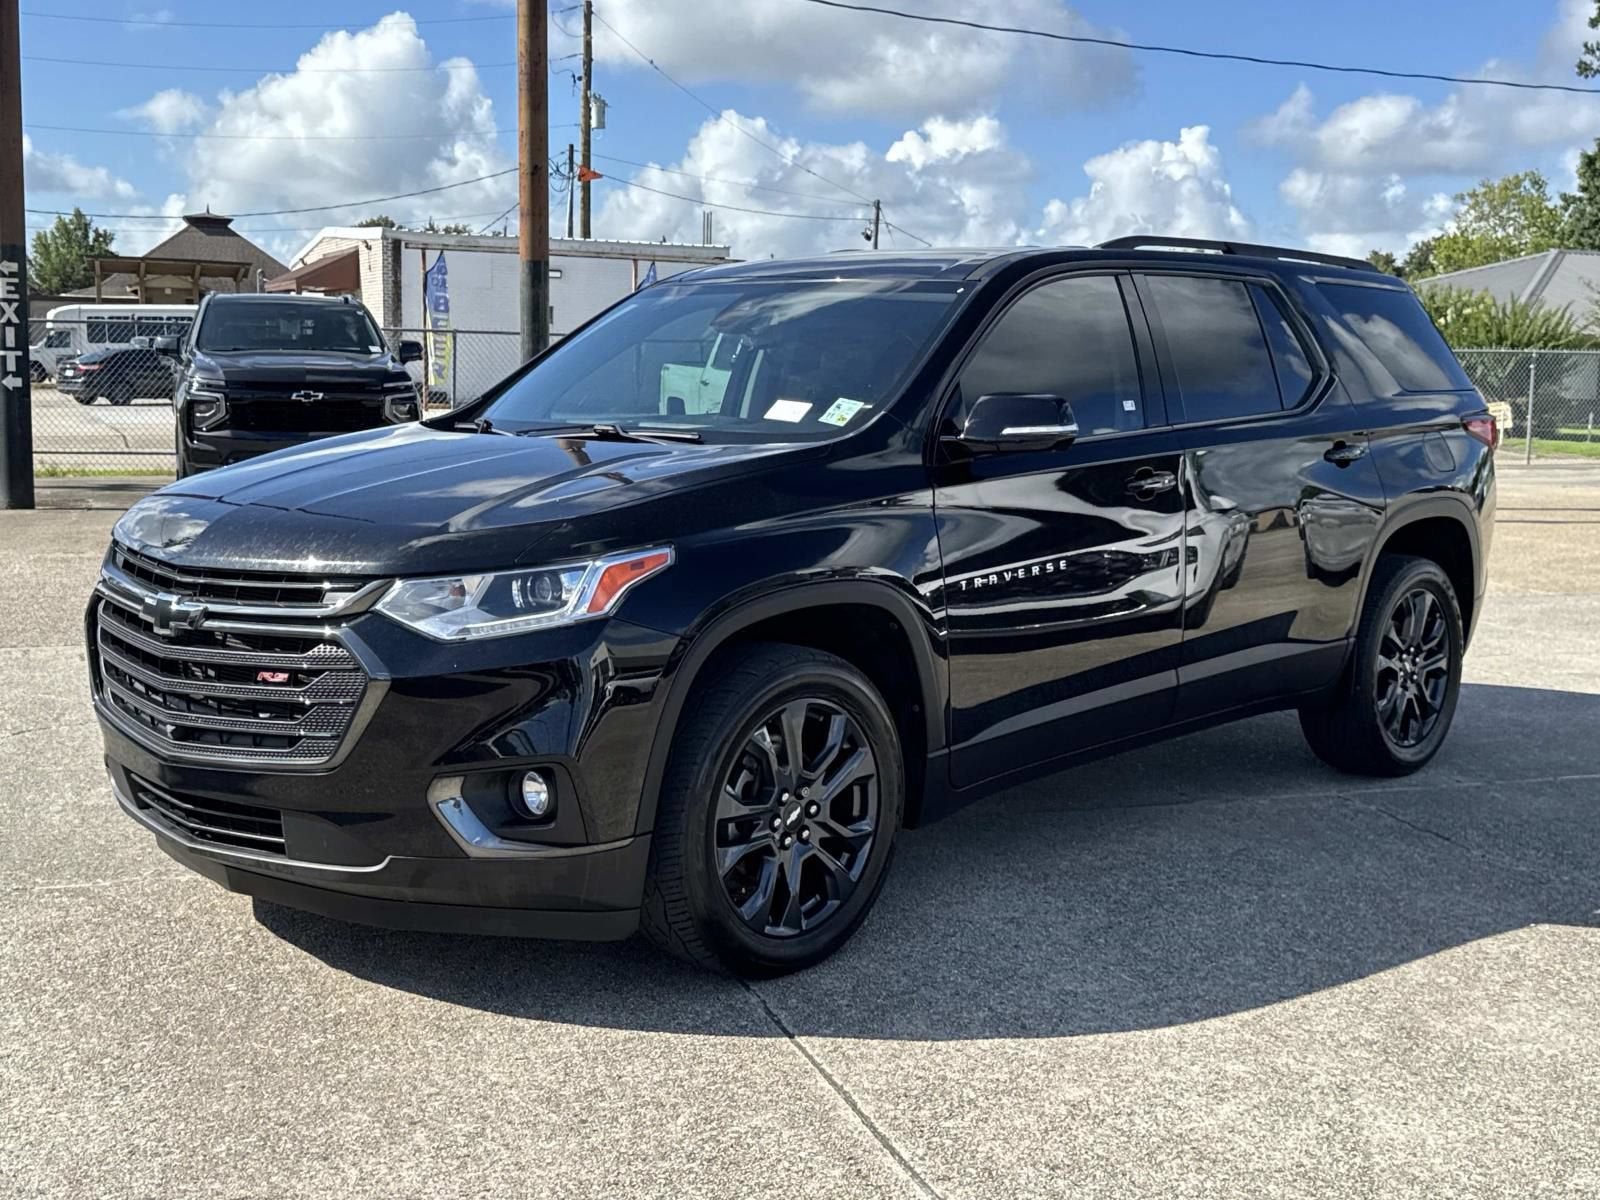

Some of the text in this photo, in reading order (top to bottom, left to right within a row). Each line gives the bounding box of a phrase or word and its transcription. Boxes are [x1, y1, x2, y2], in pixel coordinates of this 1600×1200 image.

[0, 277, 23, 372] EXIT
[960, 560, 1067, 591] TRAVERSE
[257, 671, 289, 682] RS
